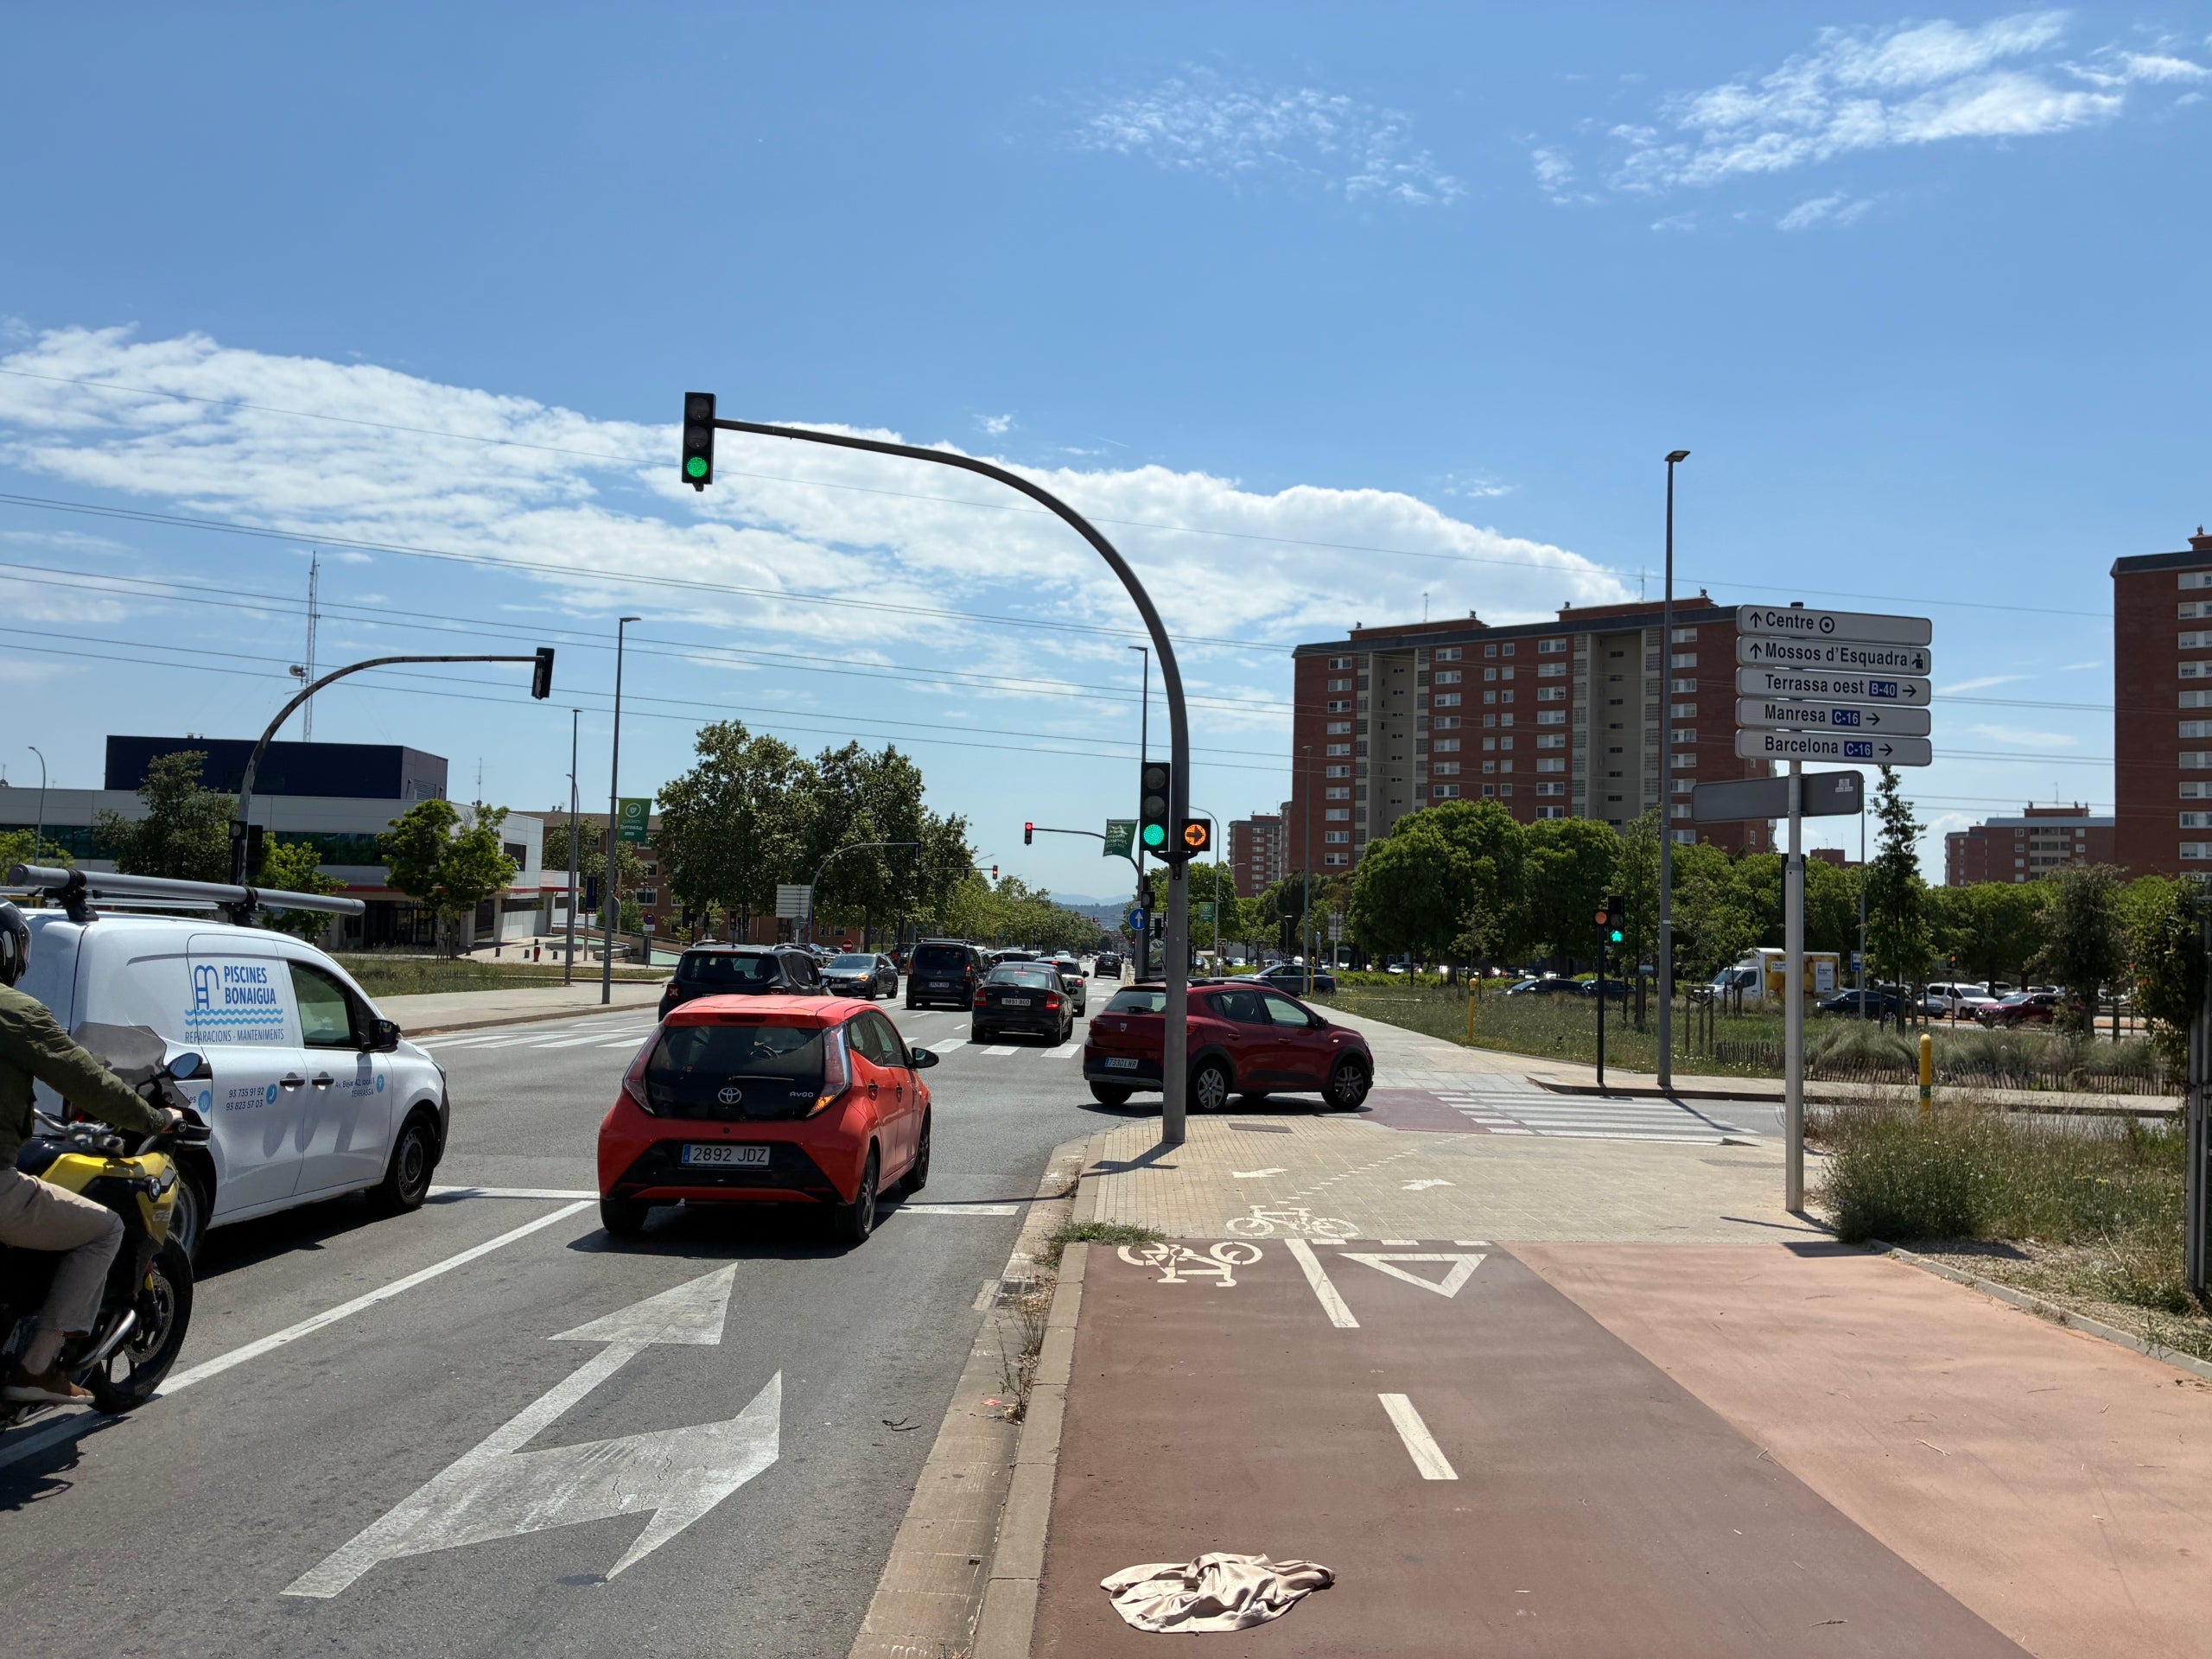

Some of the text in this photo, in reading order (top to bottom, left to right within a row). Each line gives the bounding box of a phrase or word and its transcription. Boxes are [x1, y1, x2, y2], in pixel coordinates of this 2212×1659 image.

[1766, 612, 1814, 629] Centre
[1765, 642, 1907, 667] Mossos d'Esquadra
[1765, 674, 1896, 696] Terrassa oest B-40
[1765, 704, 1859, 724] Manresa C-16
[1765, 735, 1871, 756] Barcelona C-16
[224, 965, 267, 984] PISCINES
[225, 987, 276, 1005] BONAIGUA
[185, 1030, 232, 1044] REPARACIONS
[237, 1028, 284, 1042] MANTENIMENTS
[229, 1087, 264, 1098] 93 735 91 92
[226, 1103, 234, 1111] 93
[234, 1102, 246, 1110] 823
[255, 1099, 264, 1109] 03
[693, 1147, 766, 1162] 2892 JDZ
